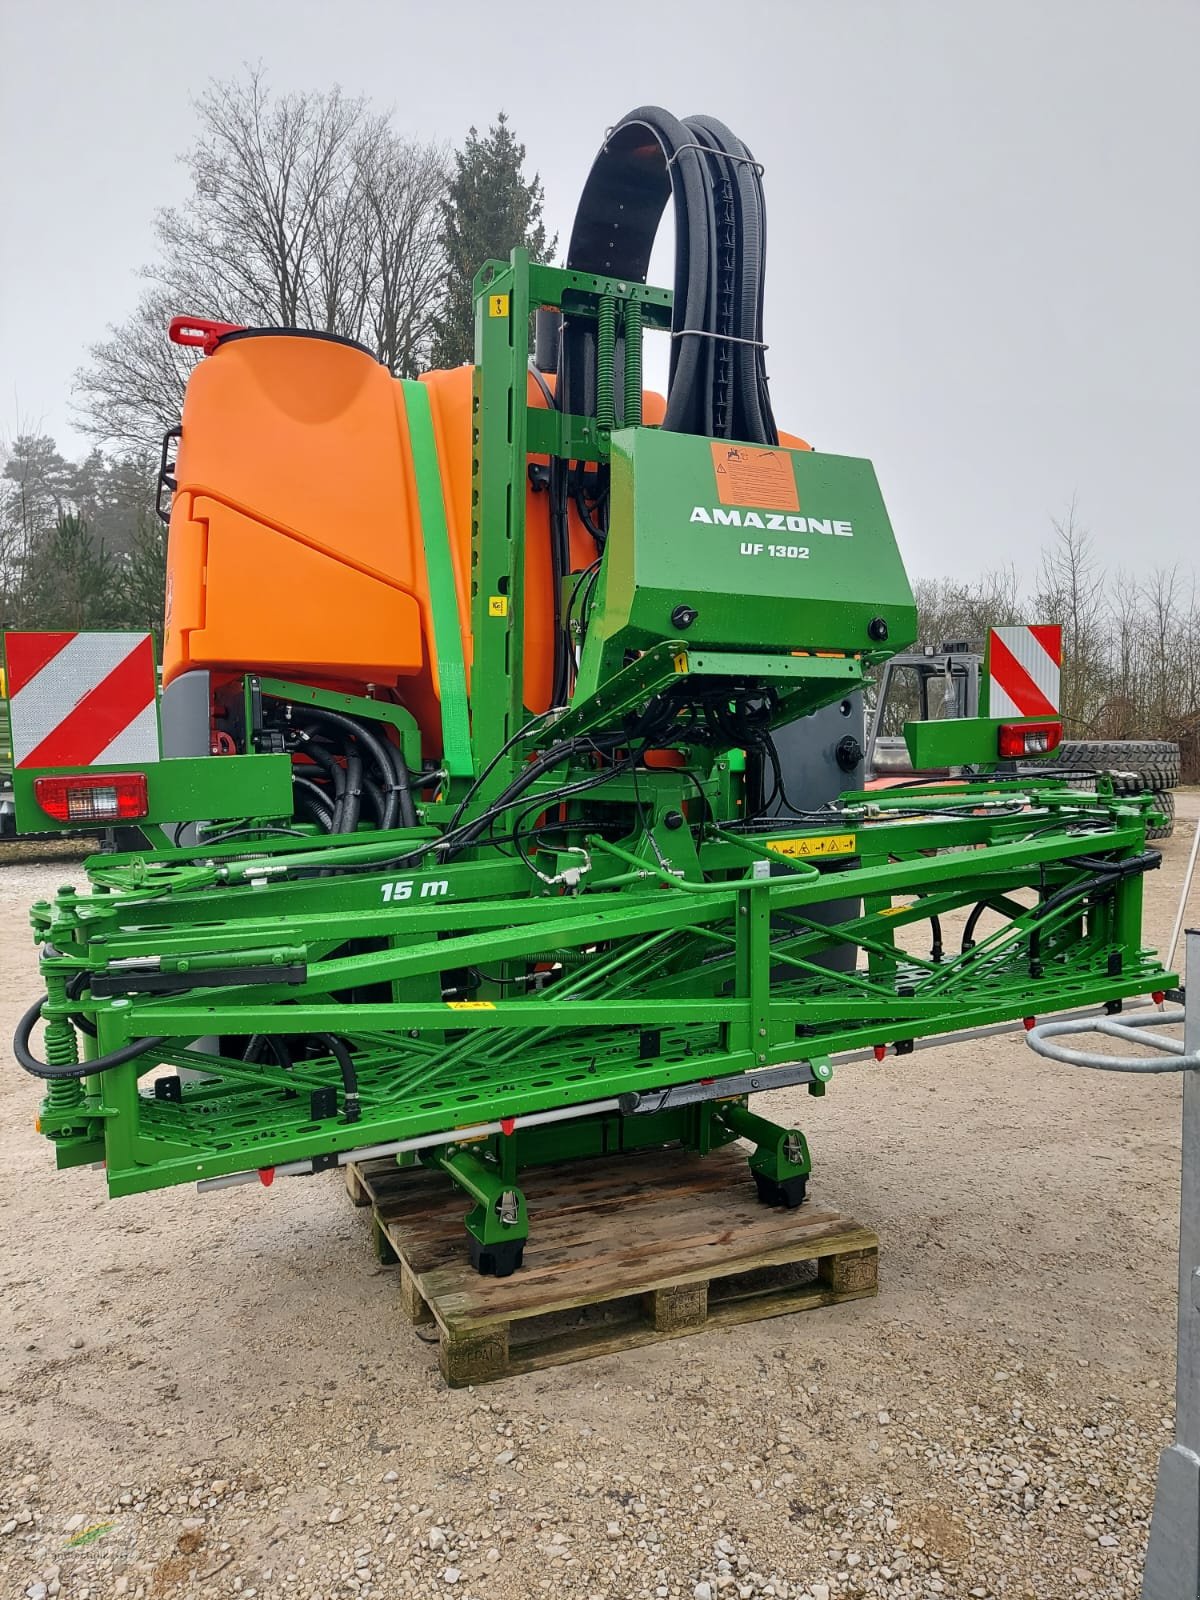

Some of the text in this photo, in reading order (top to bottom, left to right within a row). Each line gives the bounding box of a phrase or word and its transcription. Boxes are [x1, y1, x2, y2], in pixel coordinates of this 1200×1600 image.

[689, 506, 854, 537] AMAZONE
[740, 542, 810, 559] UF 1302
[381, 880, 449, 902] 15 m
